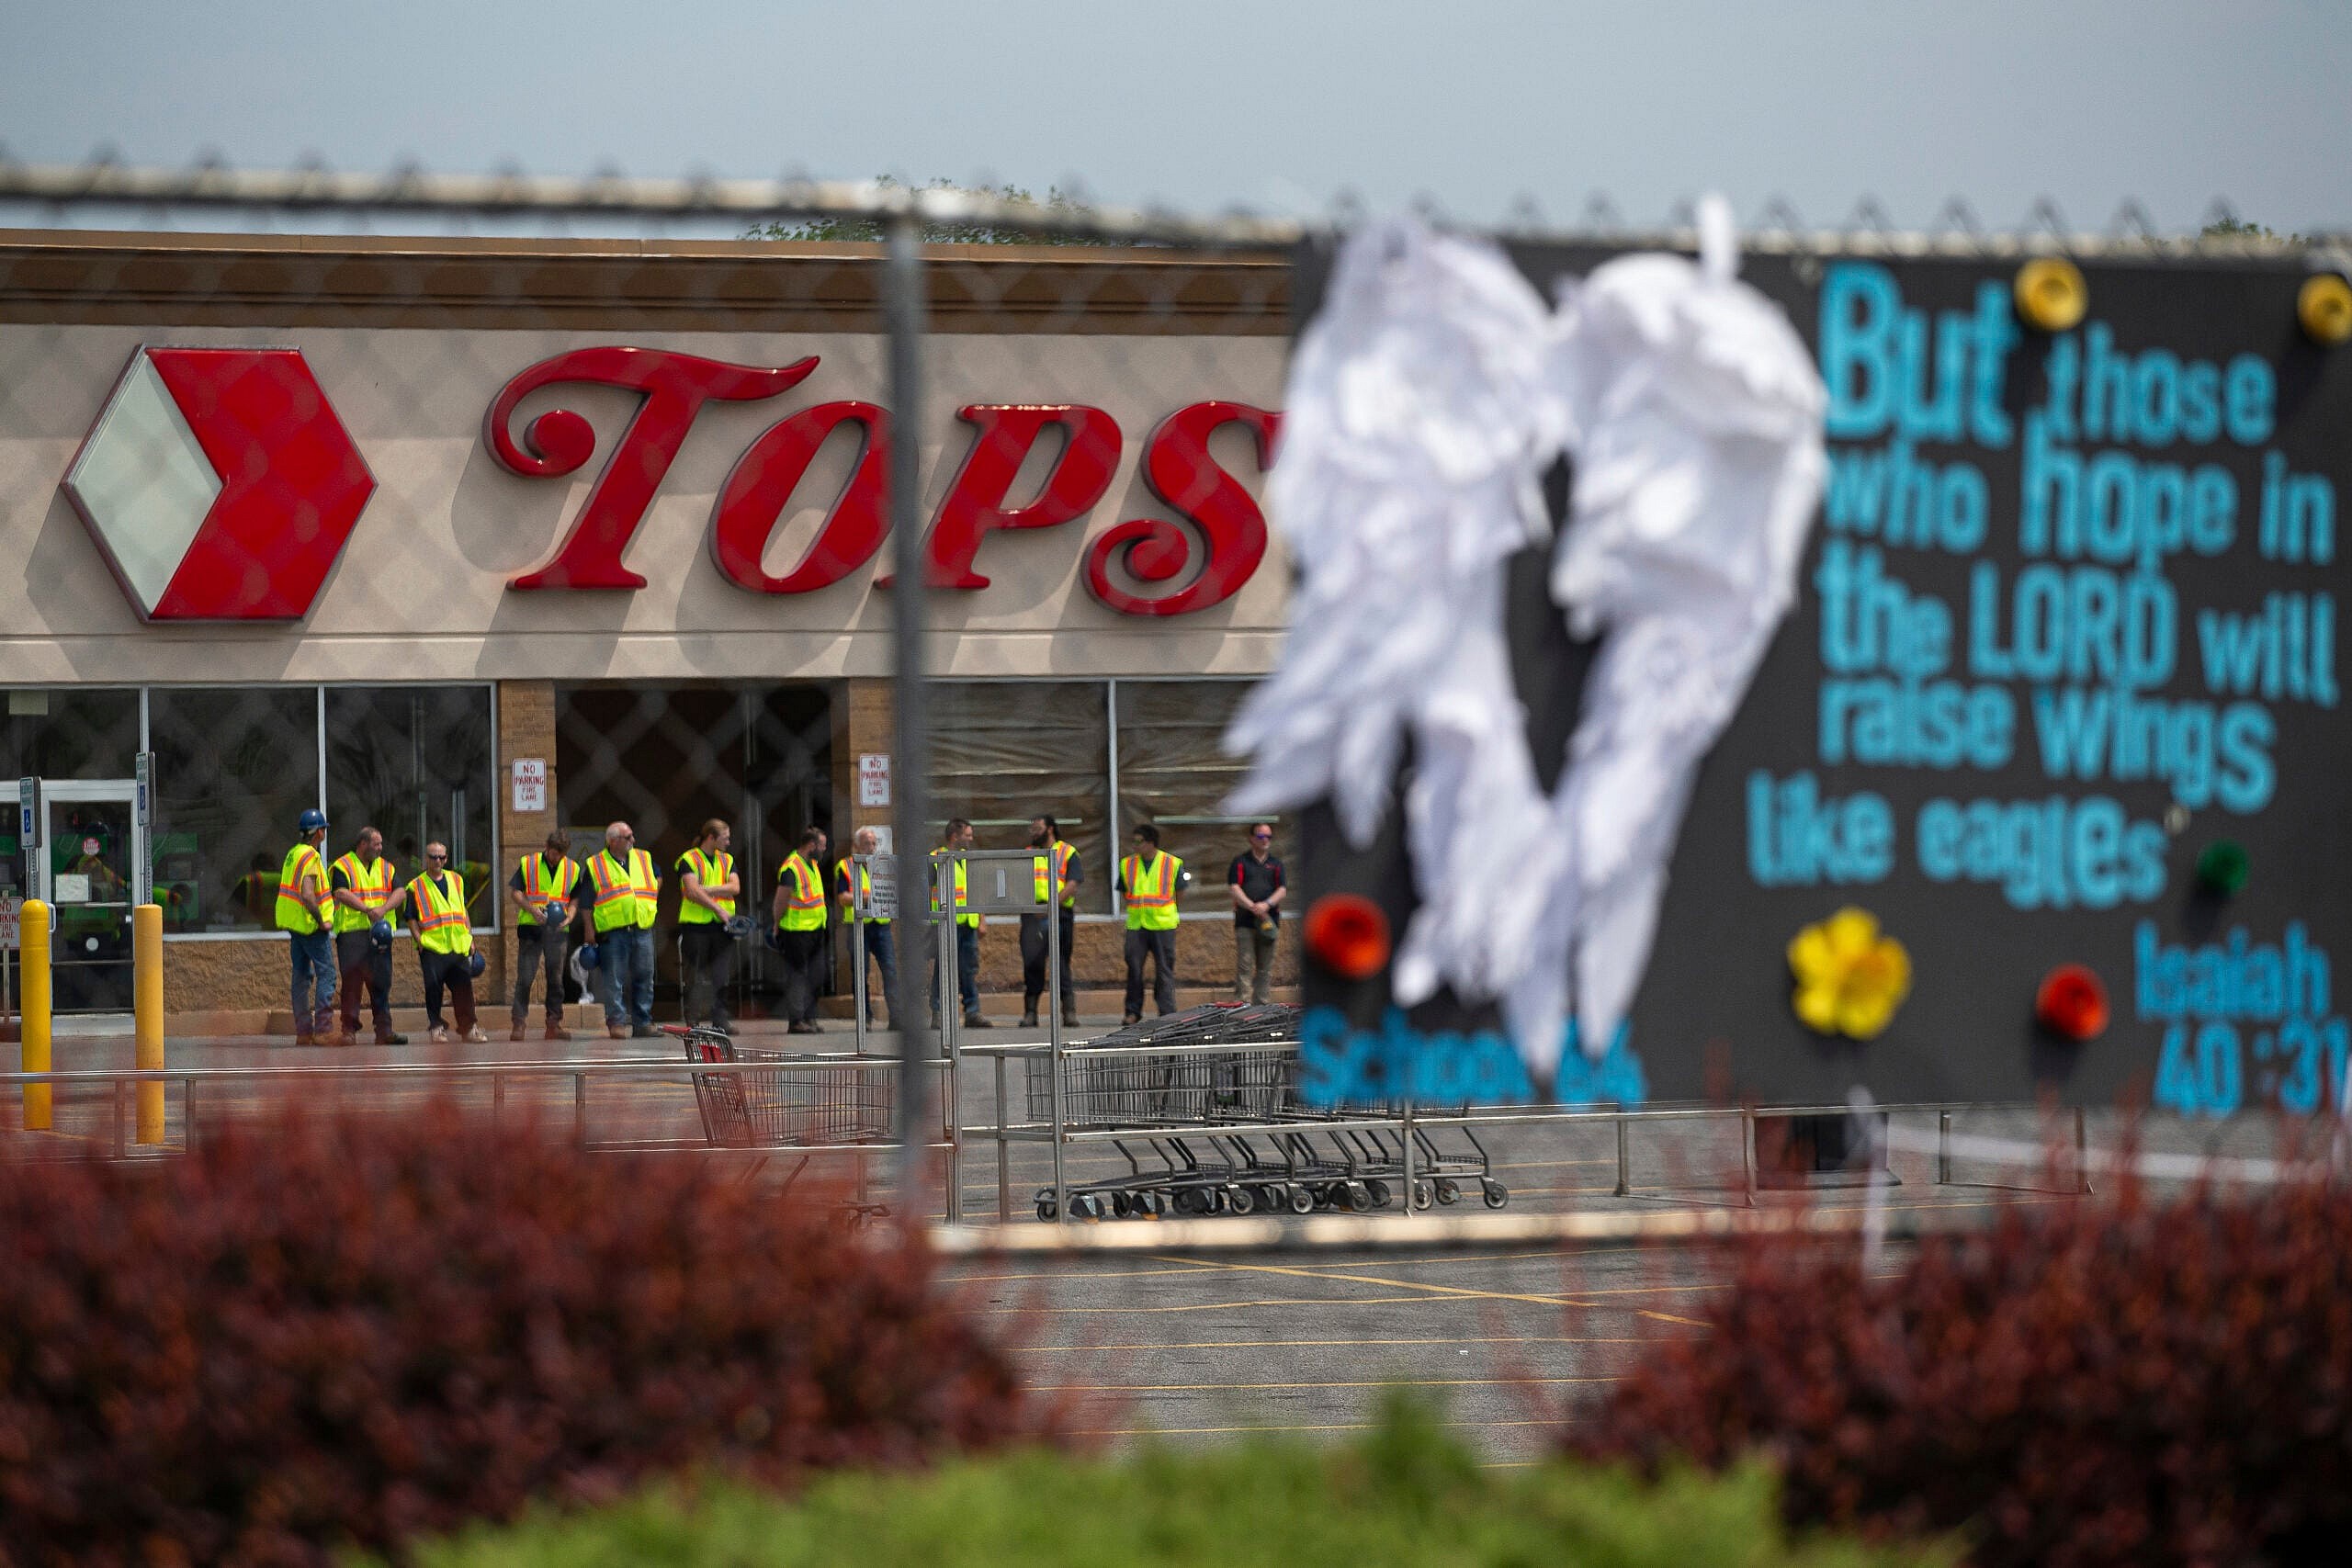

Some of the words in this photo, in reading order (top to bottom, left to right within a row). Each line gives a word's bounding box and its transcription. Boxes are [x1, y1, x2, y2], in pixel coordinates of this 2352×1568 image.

[1818, 265, 2018, 446] But
[2047, 321, 2277, 445] those
[1823, 439, 1988, 551] who
[2021, 408, 2240, 577] hope
[2260, 450, 2336, 562] in
[1815, 540, 1951, 682] the
[1969, 558, 2179, 691] LORD
[2199, 592, 2339, 705] will
[523, 764, 536, 774] NO
[870, 761, 882, 769] NO
[1818, 674, 2016, 770] raise
[515, 776, 544, 785] PARKING
[1916, 794, 2168, 909] eagles
[2133, 919, 2332, 1021] Isaiah
